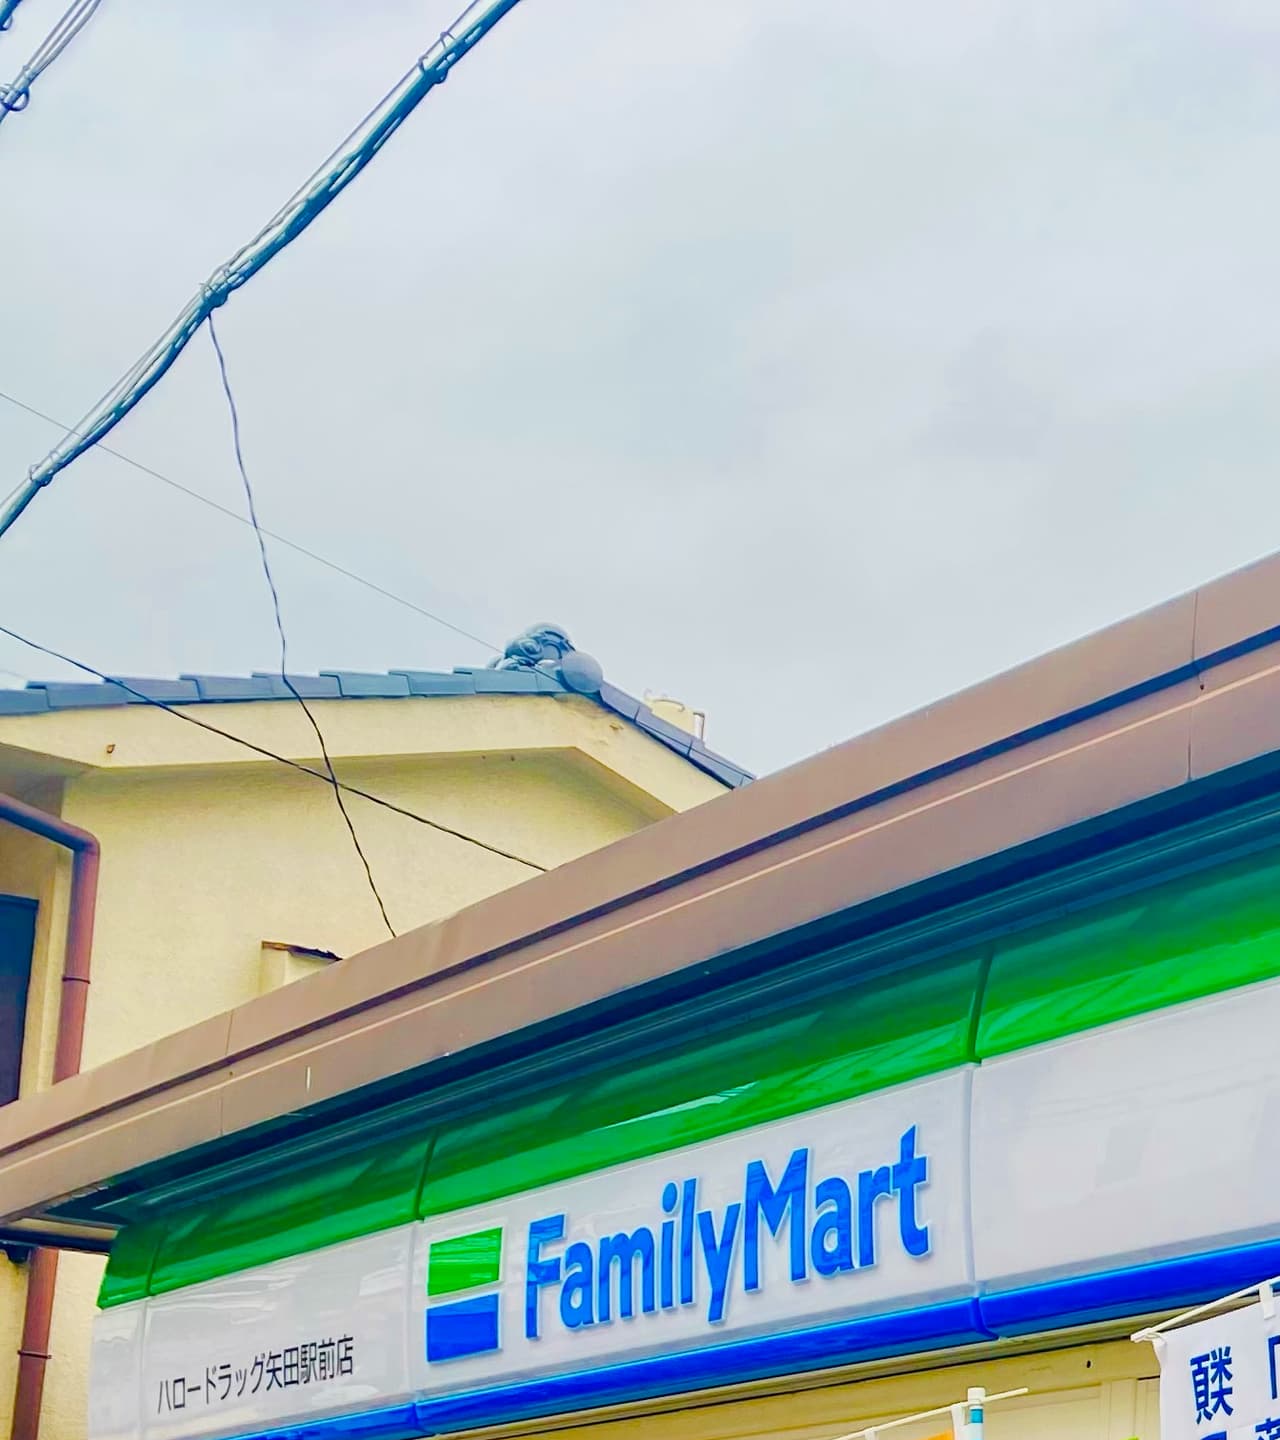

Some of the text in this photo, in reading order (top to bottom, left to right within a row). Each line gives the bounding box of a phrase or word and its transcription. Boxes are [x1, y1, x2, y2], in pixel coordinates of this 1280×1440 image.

[525, 1123, 931, 1340] FamilyMart
[157, 1334, 355, 1413] ハロードラッグ矢田駅前店
